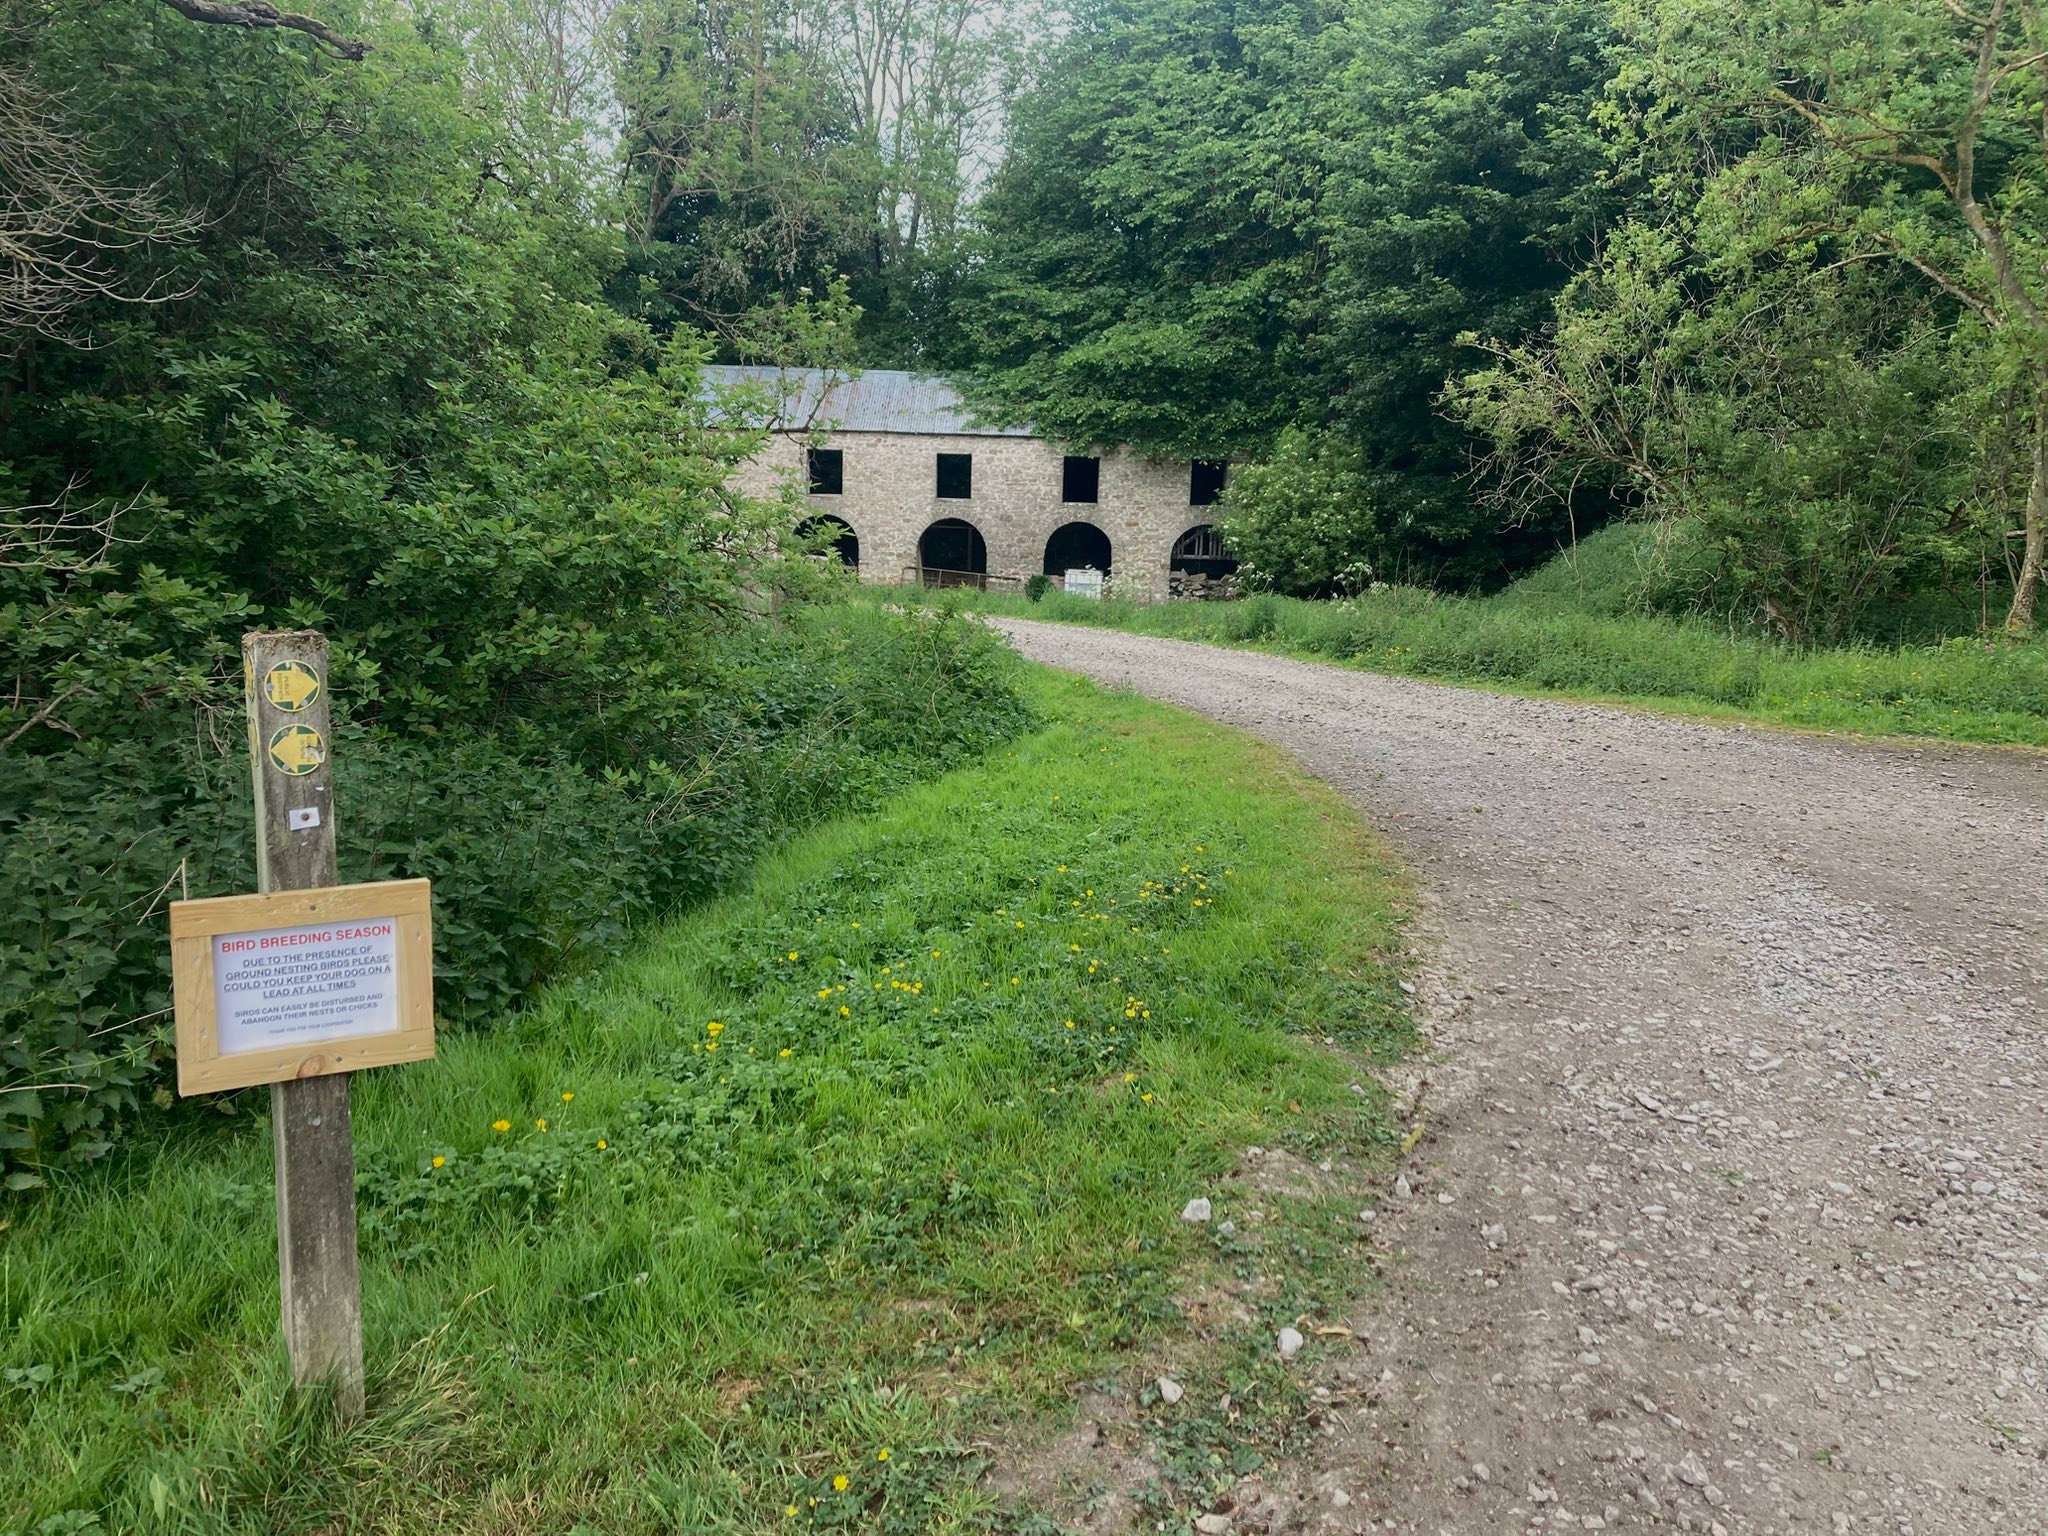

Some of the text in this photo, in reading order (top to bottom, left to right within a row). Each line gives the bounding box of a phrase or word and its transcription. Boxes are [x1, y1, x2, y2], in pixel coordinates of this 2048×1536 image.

[222, 925, 391, 952] BIRD BREEDING SEASON
[226, 954, 389, 982] GROUND NESTING BIRDS PLEASE
[243, 945, 374, 968] DUE TO THE PRESENCE OF
[224, 964, 391, 992] COULD YOU KEEP YOUR DOG ON A
[263, 980, 356, 999] LEAD AT ALL TIMES
[234, 1009, 260, 1018] BIRDS
[262, 1007, 279, 1015] CAN
[281, 1003, 308, 1013] EASILY
[322, 994, 366, 1007] DISTURBED
[366, 992, 383, 1001] AND
[241, 1016, 282, 1026] ABANDON
[284, 1010, 308, 1020] THEIR
[308, 1008, 334, 1017] NESTS
[348, 1002, 378, 1012] CHICKS
